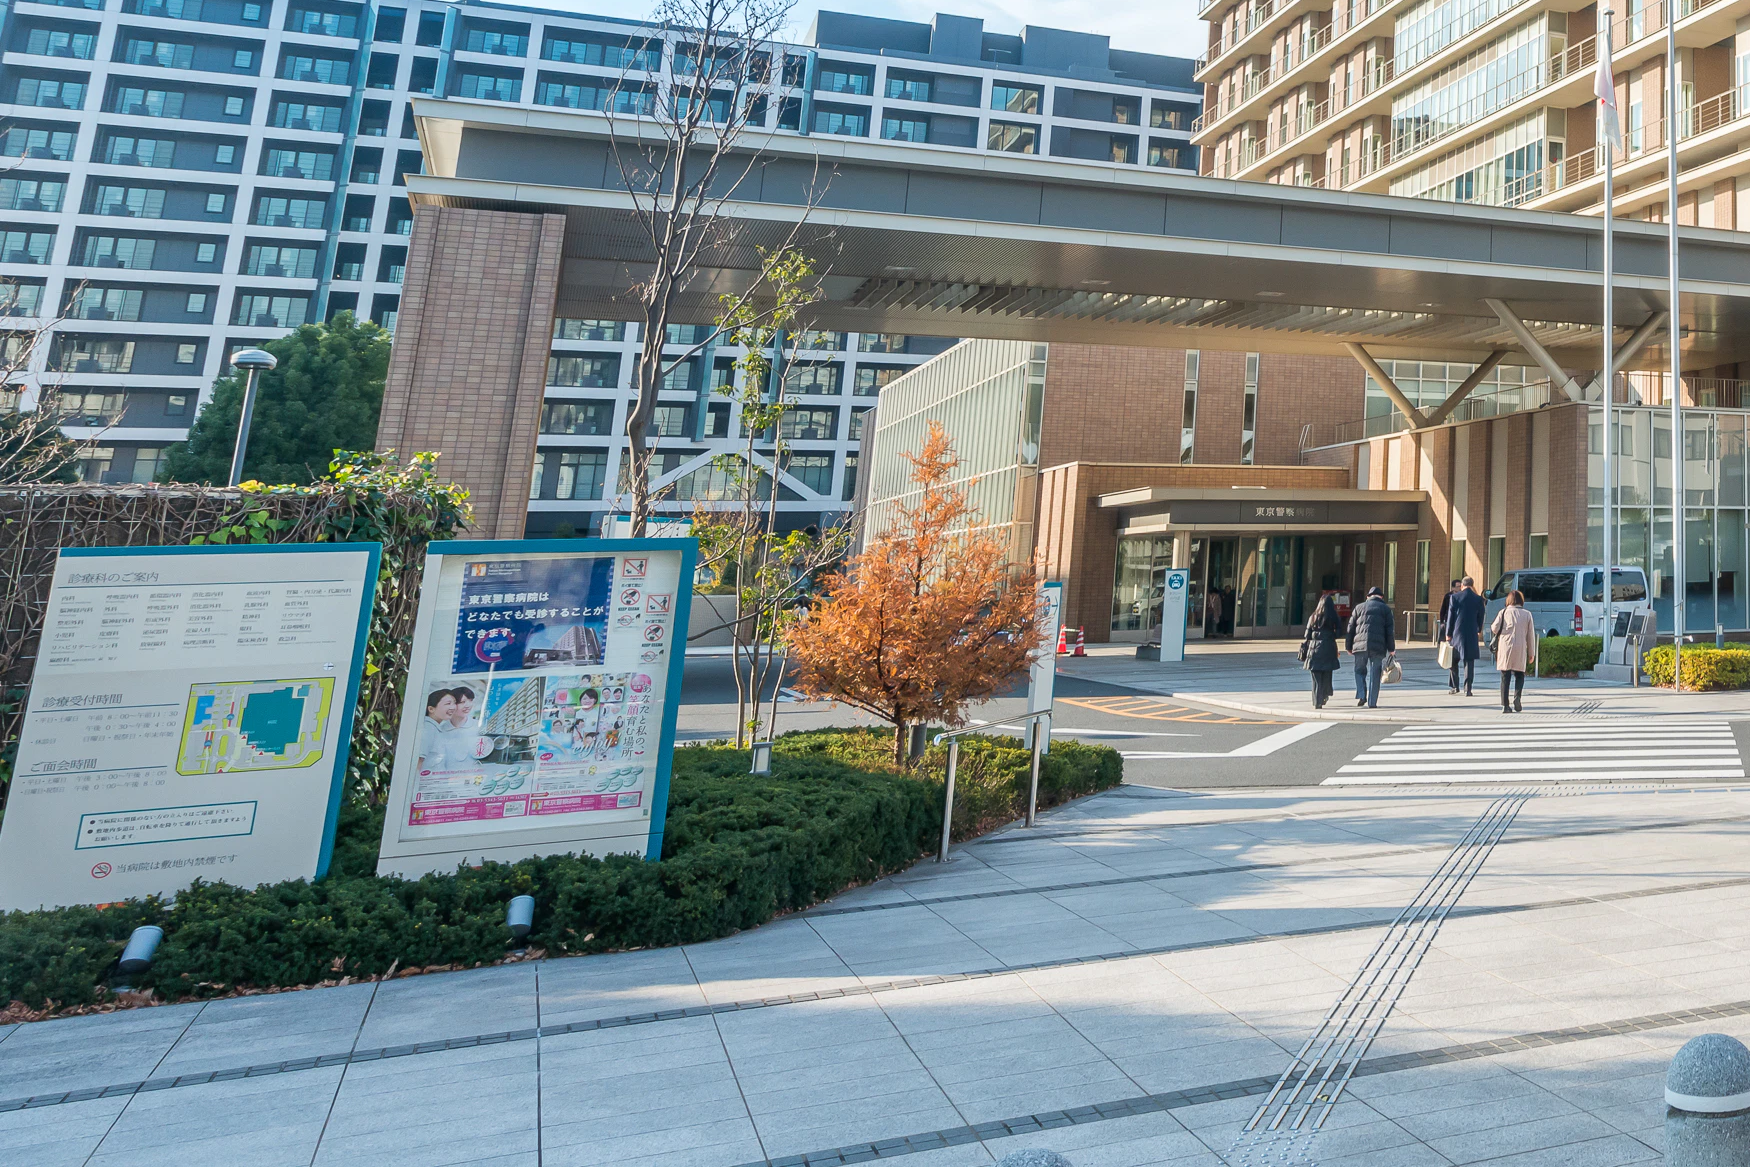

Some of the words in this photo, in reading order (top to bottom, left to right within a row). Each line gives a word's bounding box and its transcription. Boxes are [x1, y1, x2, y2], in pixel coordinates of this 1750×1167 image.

[68, 572, 159, 584] 診療科のご案内
[468, 592, 550, 605] 東京警察病院は
[467, 605, 604, 622] どなたでも受診することが
[464, 627, 516, 639] できます。
[42, 693, 123, 708] 診療受付時間
[30, 758, 98, 772] ご面会時間
[116, 854, 238, 873] 当病院は敷地内禁煙です
